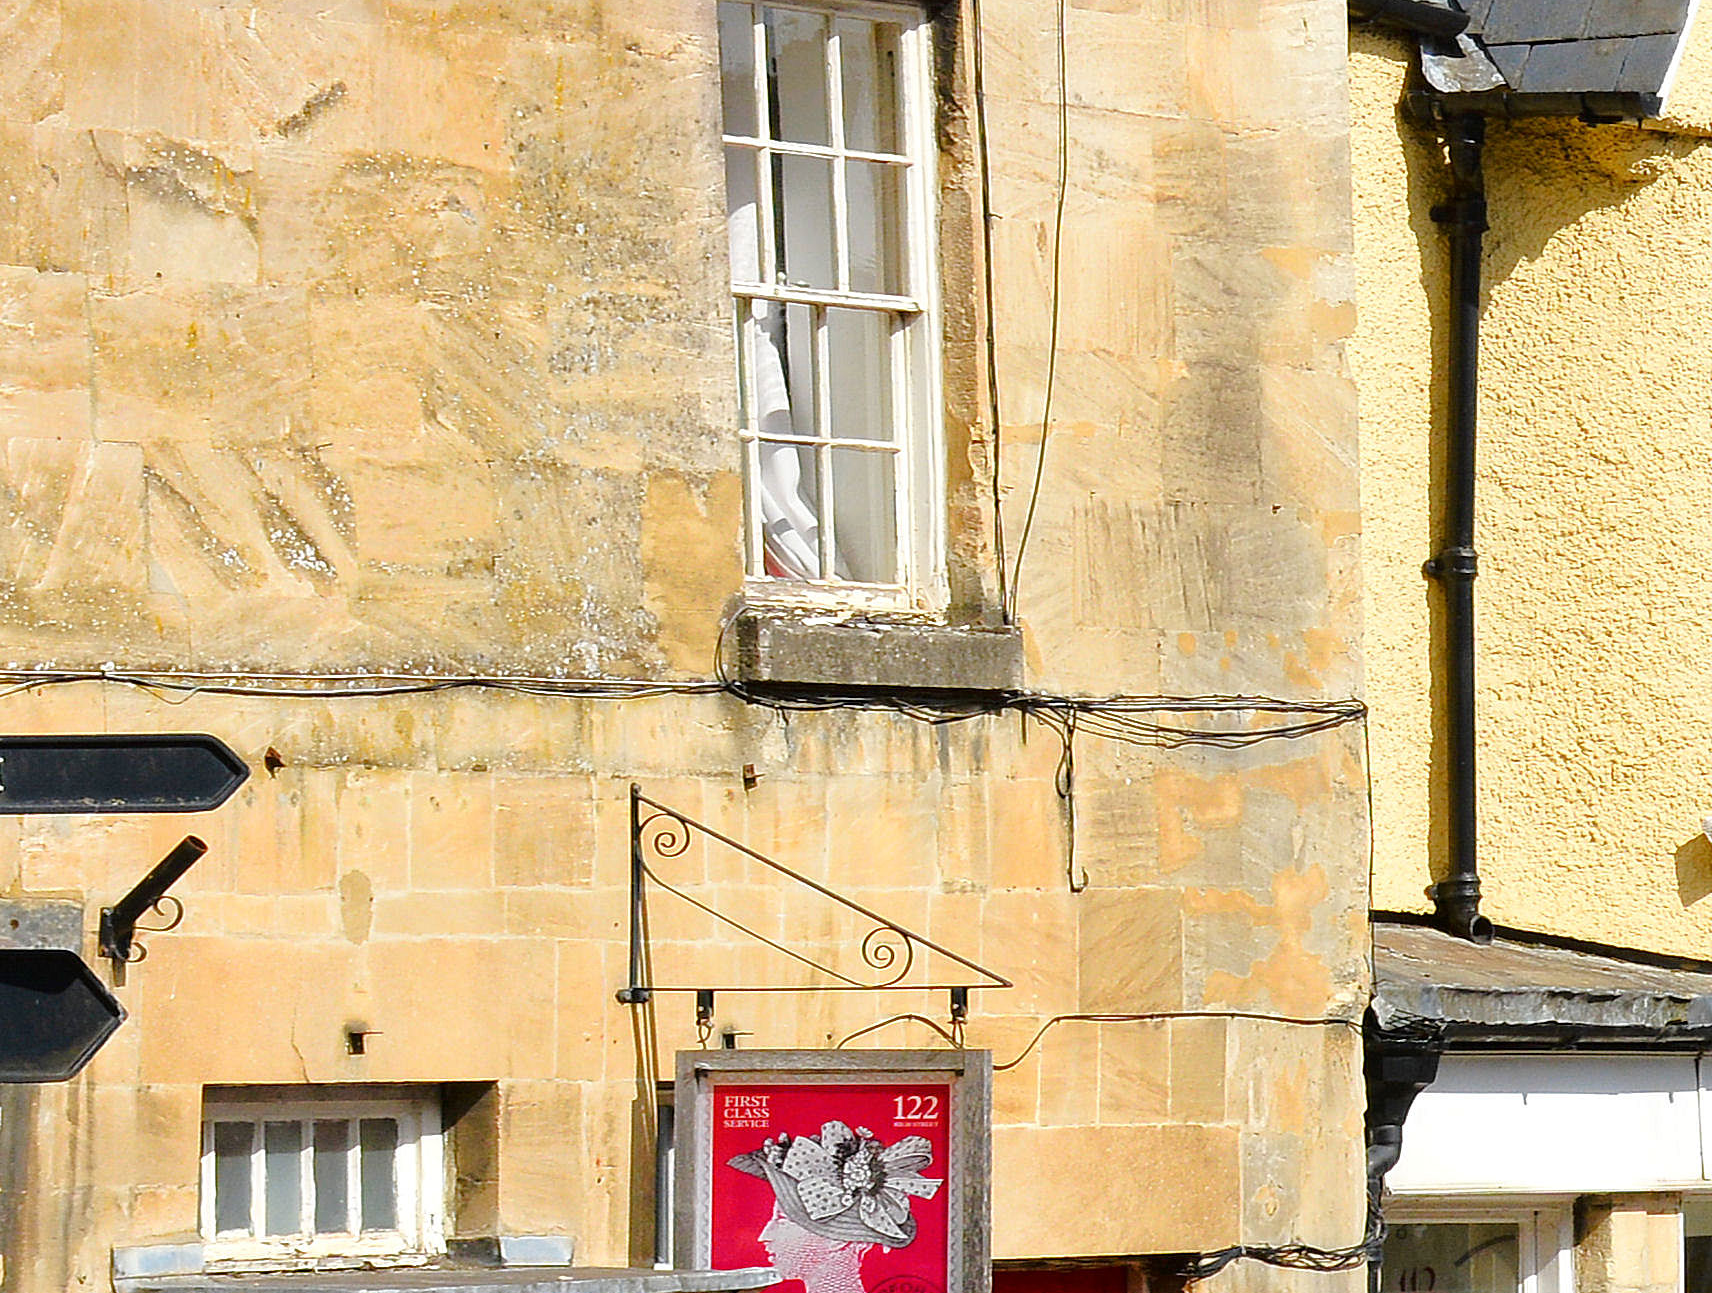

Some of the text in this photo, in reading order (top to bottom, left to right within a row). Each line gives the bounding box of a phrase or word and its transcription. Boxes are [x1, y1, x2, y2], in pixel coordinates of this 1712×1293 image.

[724, 1096, 770, 1107] FIRST
[724, 1108, 770, 1118] CLASS
[893, 1096, 939, 1120] 122
[723, 1119, 769, 1128] SERVICE
